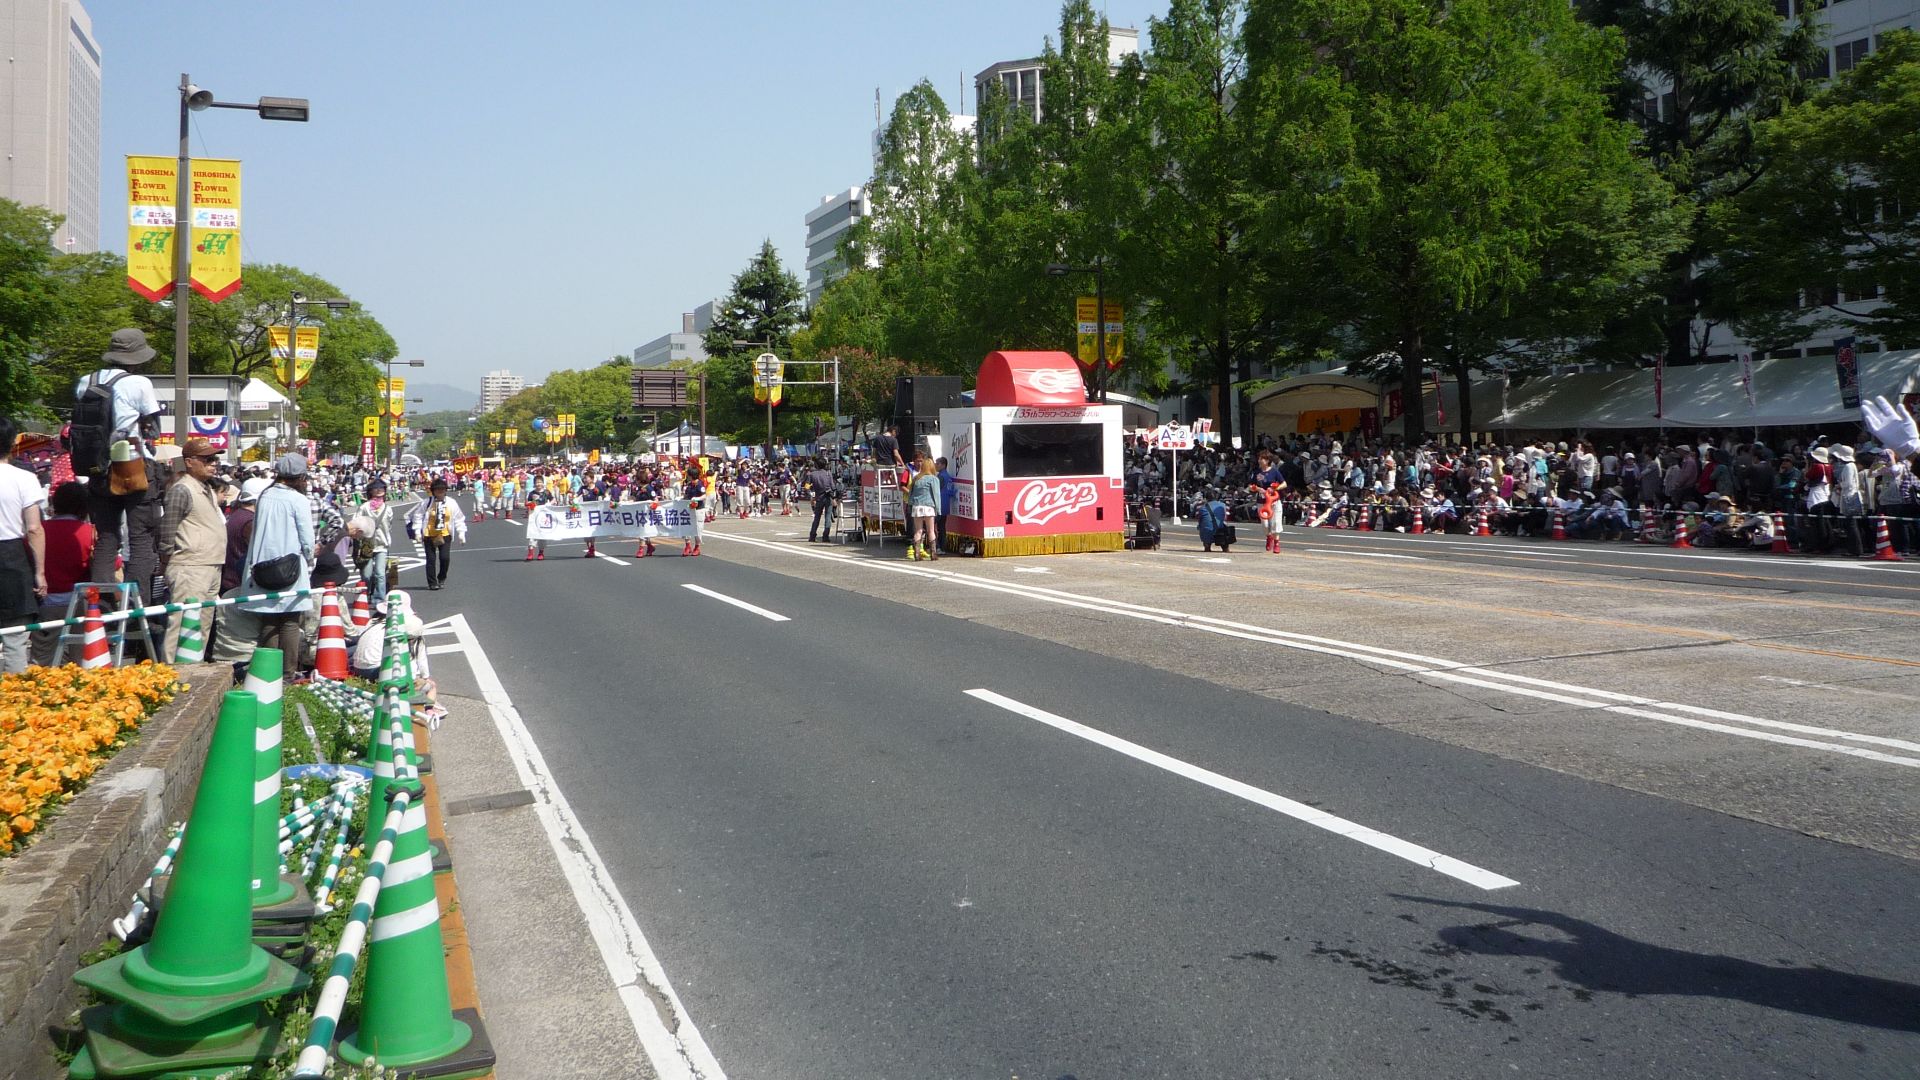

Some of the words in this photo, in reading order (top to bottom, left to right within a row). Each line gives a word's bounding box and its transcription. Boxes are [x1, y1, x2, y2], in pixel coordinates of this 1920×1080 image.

[131, 168, 175, 177] HIROSHIMA
[193, 171, 236, 179] HIROSHIMA
[131, 179, 166, 190] FLOWER
[194, 181, 228, 193] FLOWER
[132, 191, 170, 202] FESTIVAL
[194, 193, 232, 204] FESTIVAL
[1014, 480, 1098, 525] Carp
